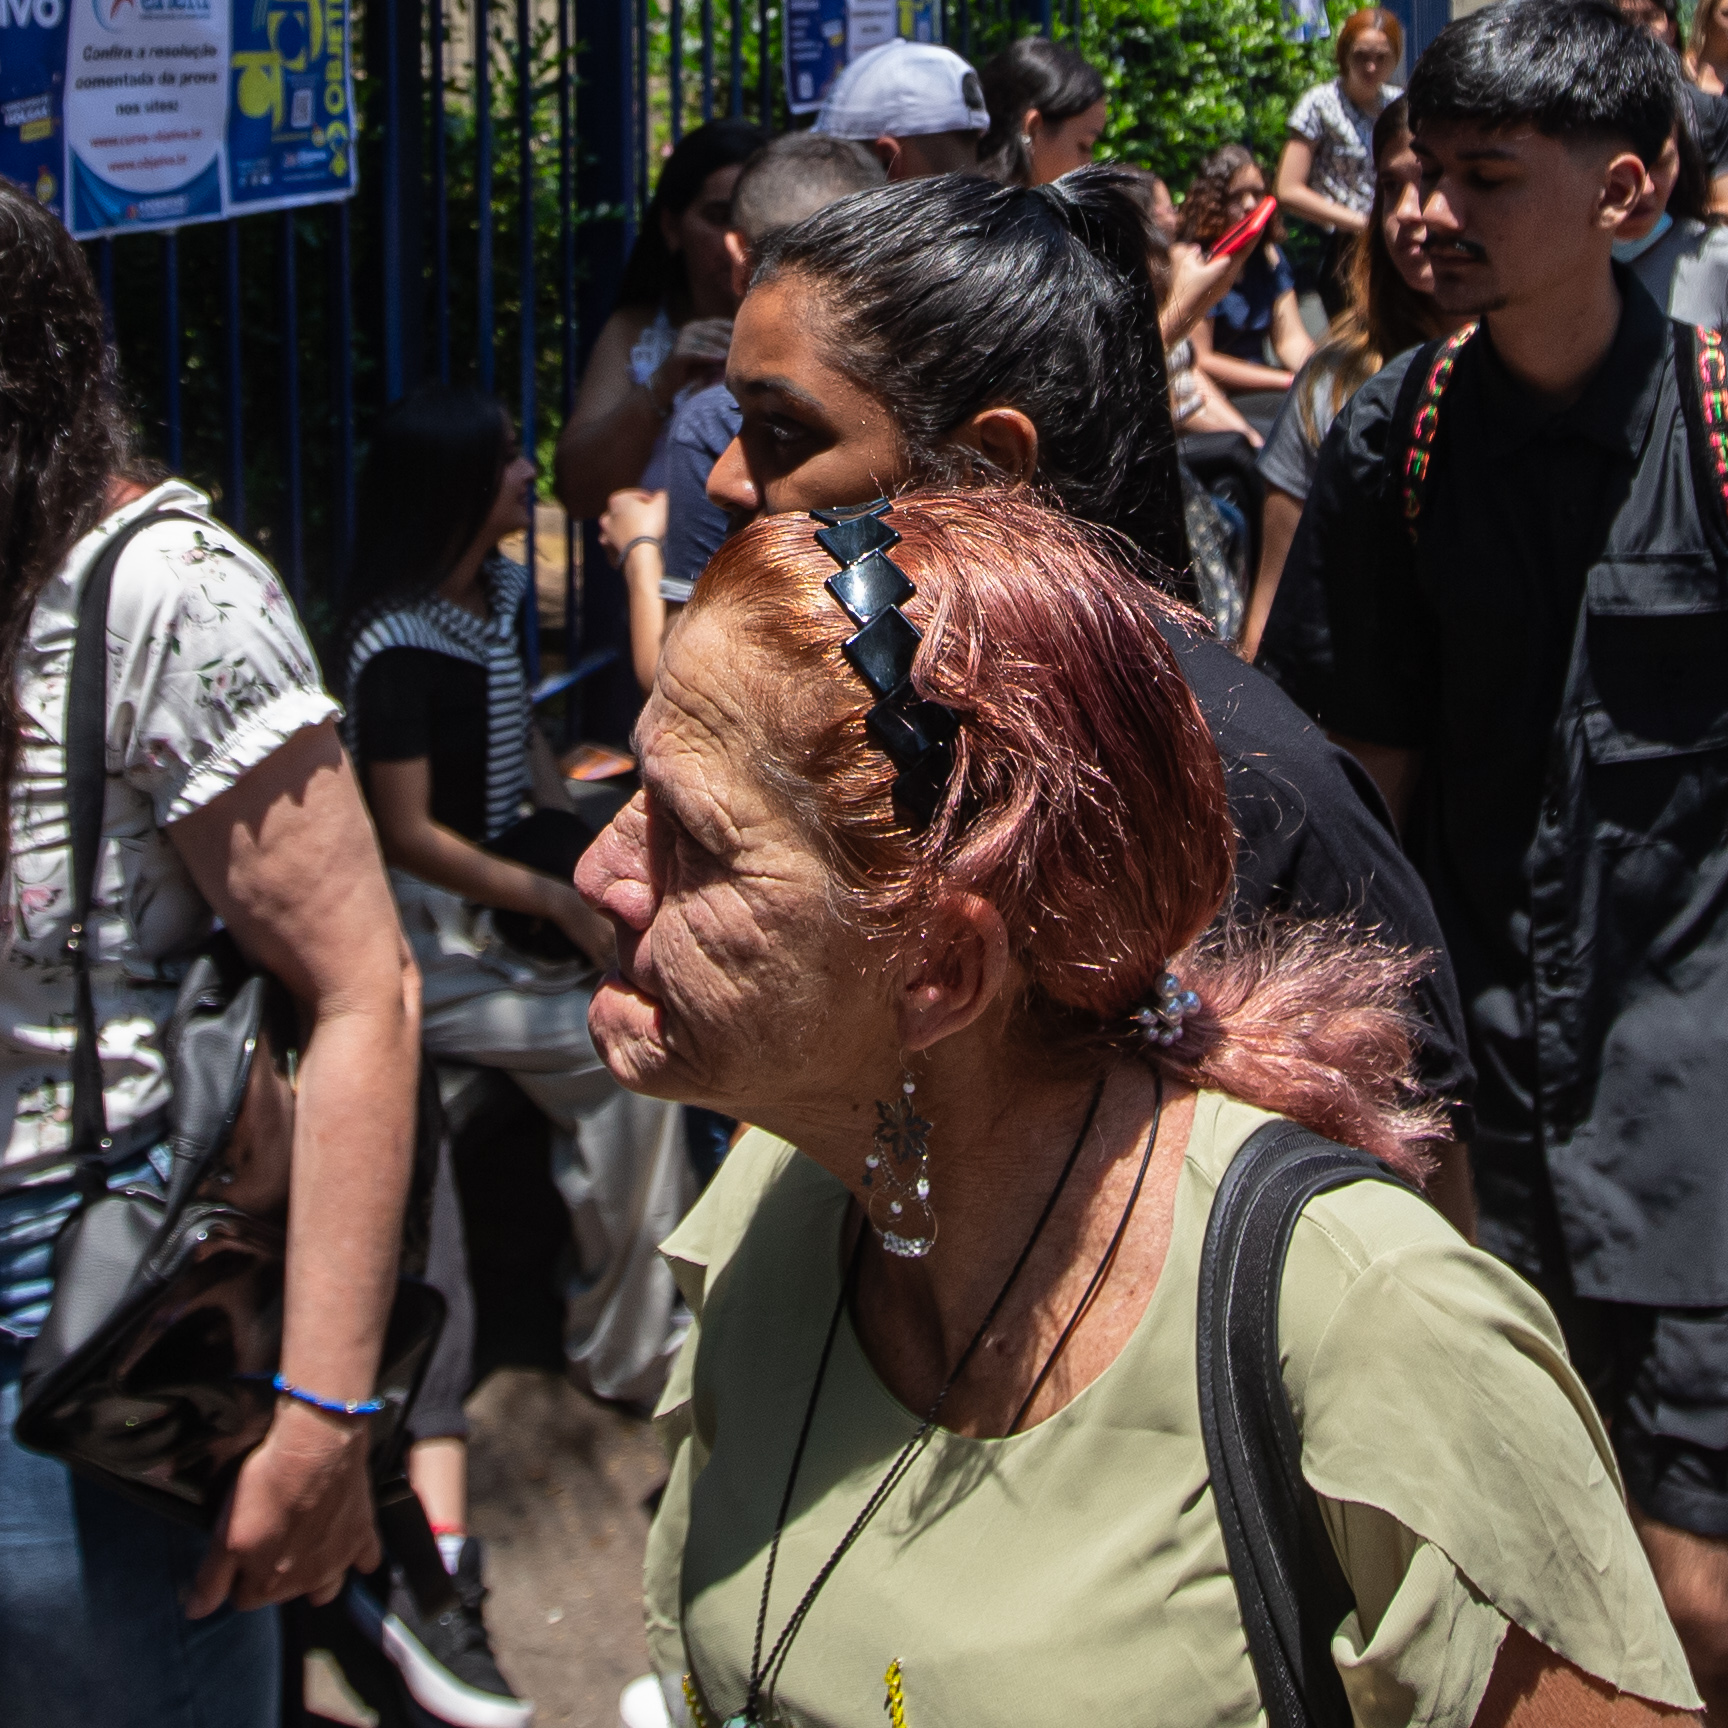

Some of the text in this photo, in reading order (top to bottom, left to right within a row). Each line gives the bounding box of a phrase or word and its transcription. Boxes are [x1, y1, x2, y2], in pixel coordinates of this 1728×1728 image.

[82, 45, 133, 62] Confira
[149, 44, 217, 62] resolução
[75, 71, 218, 90] comentada da prova
[116, 101, 140, 116] nos
